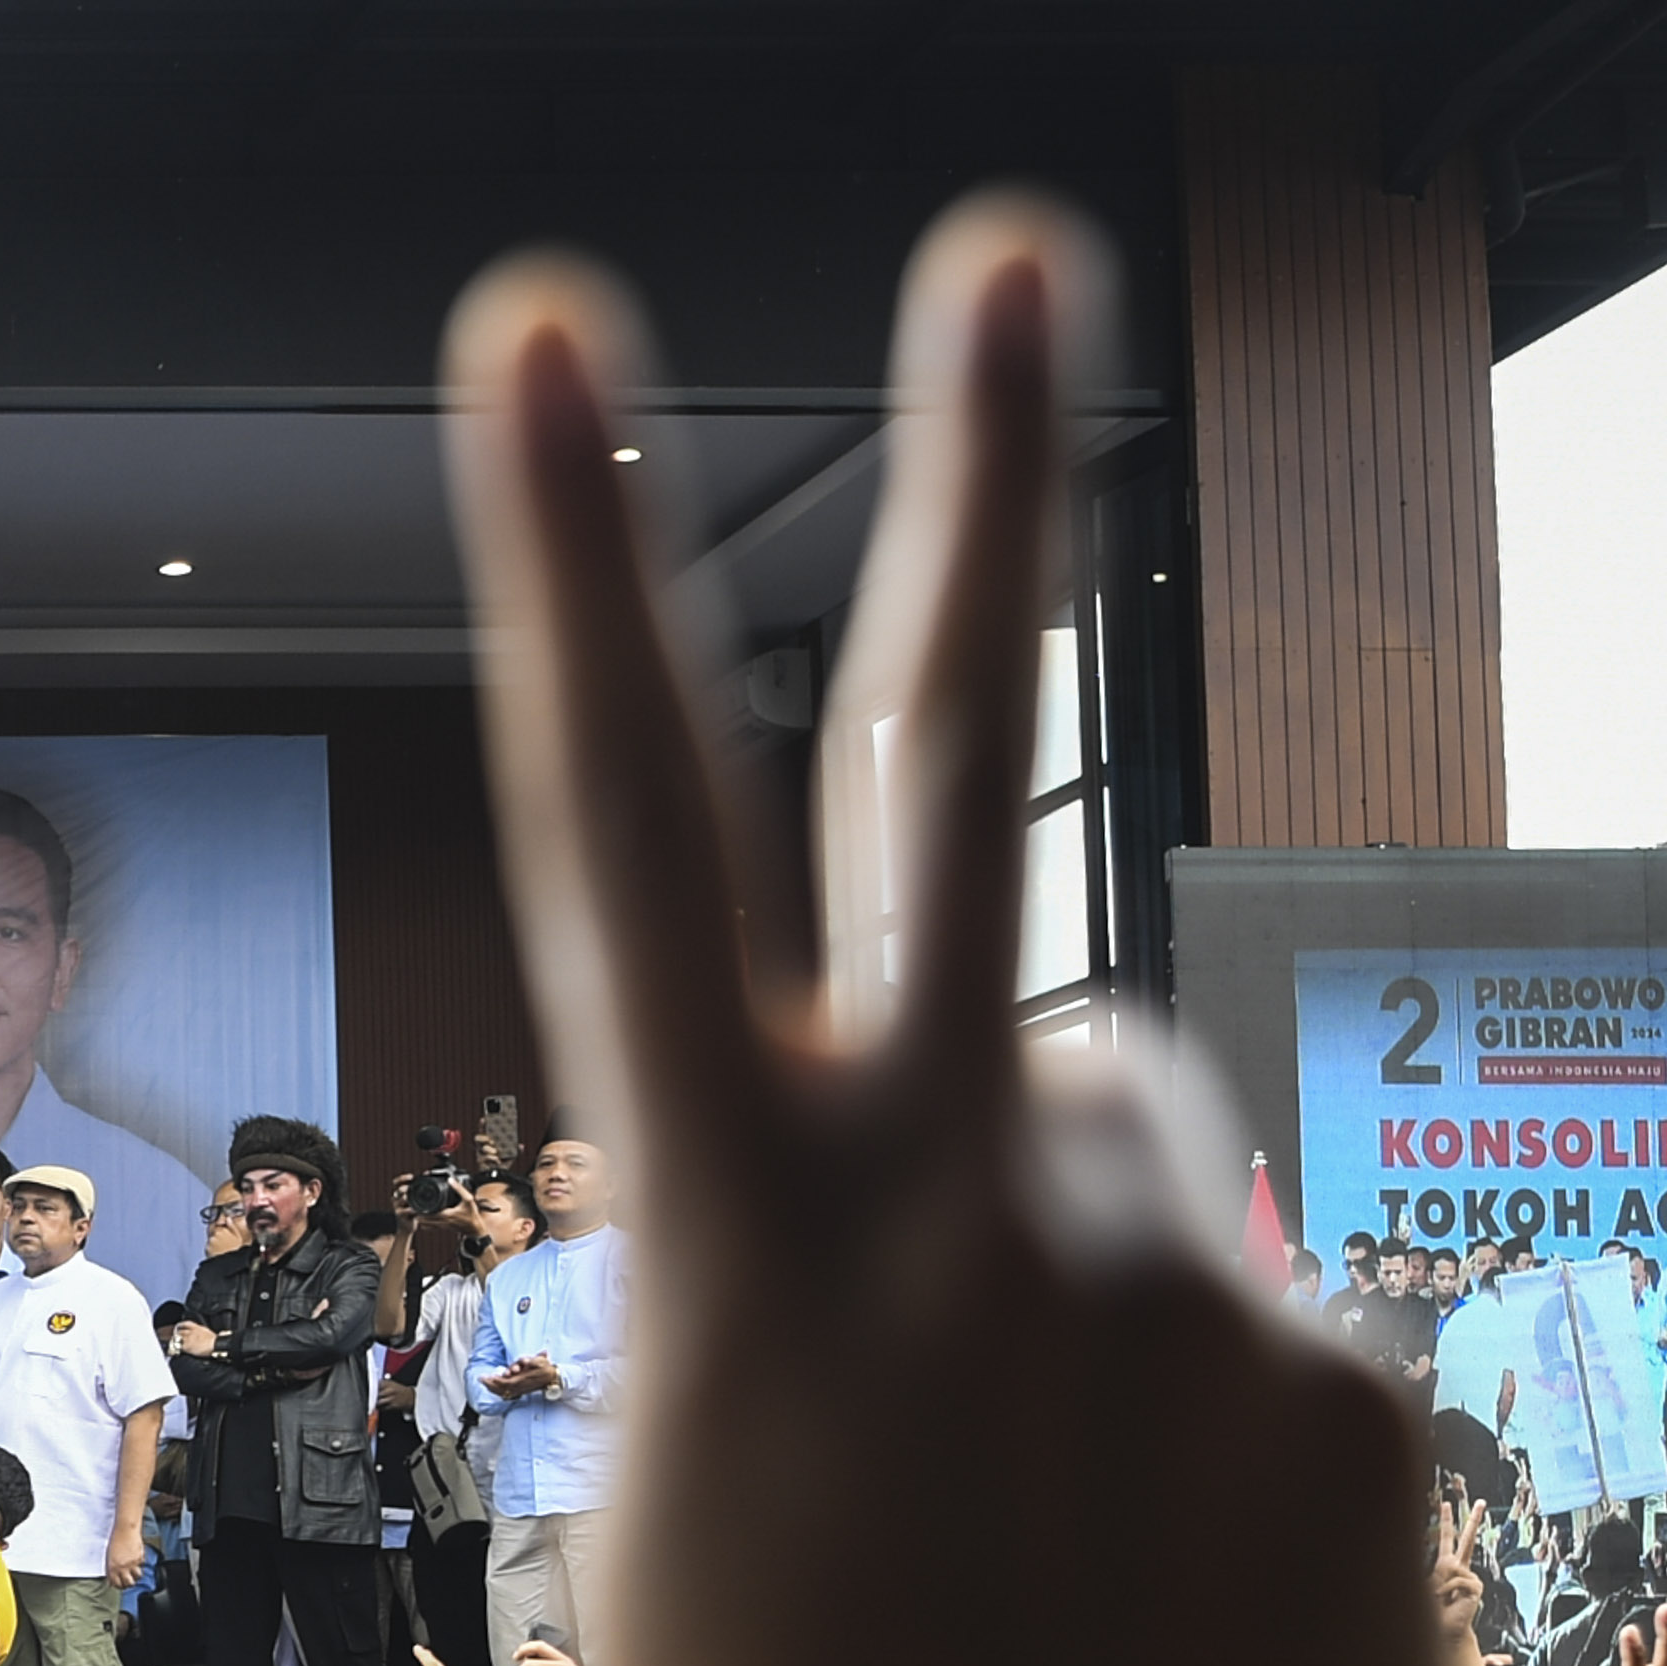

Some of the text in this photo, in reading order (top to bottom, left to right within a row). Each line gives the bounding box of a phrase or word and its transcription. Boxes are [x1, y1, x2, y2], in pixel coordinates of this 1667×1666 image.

[1474, 976, 1666, 1011] PRABOWO
[1379, 976, 1442, 1085] 2
[1474, 1015, 1623, 1050] GIBRAN
[1379, 1117, 1667, 1170] KONSOLI
[1378, 1187, 1667, 1239] TOKOH A
